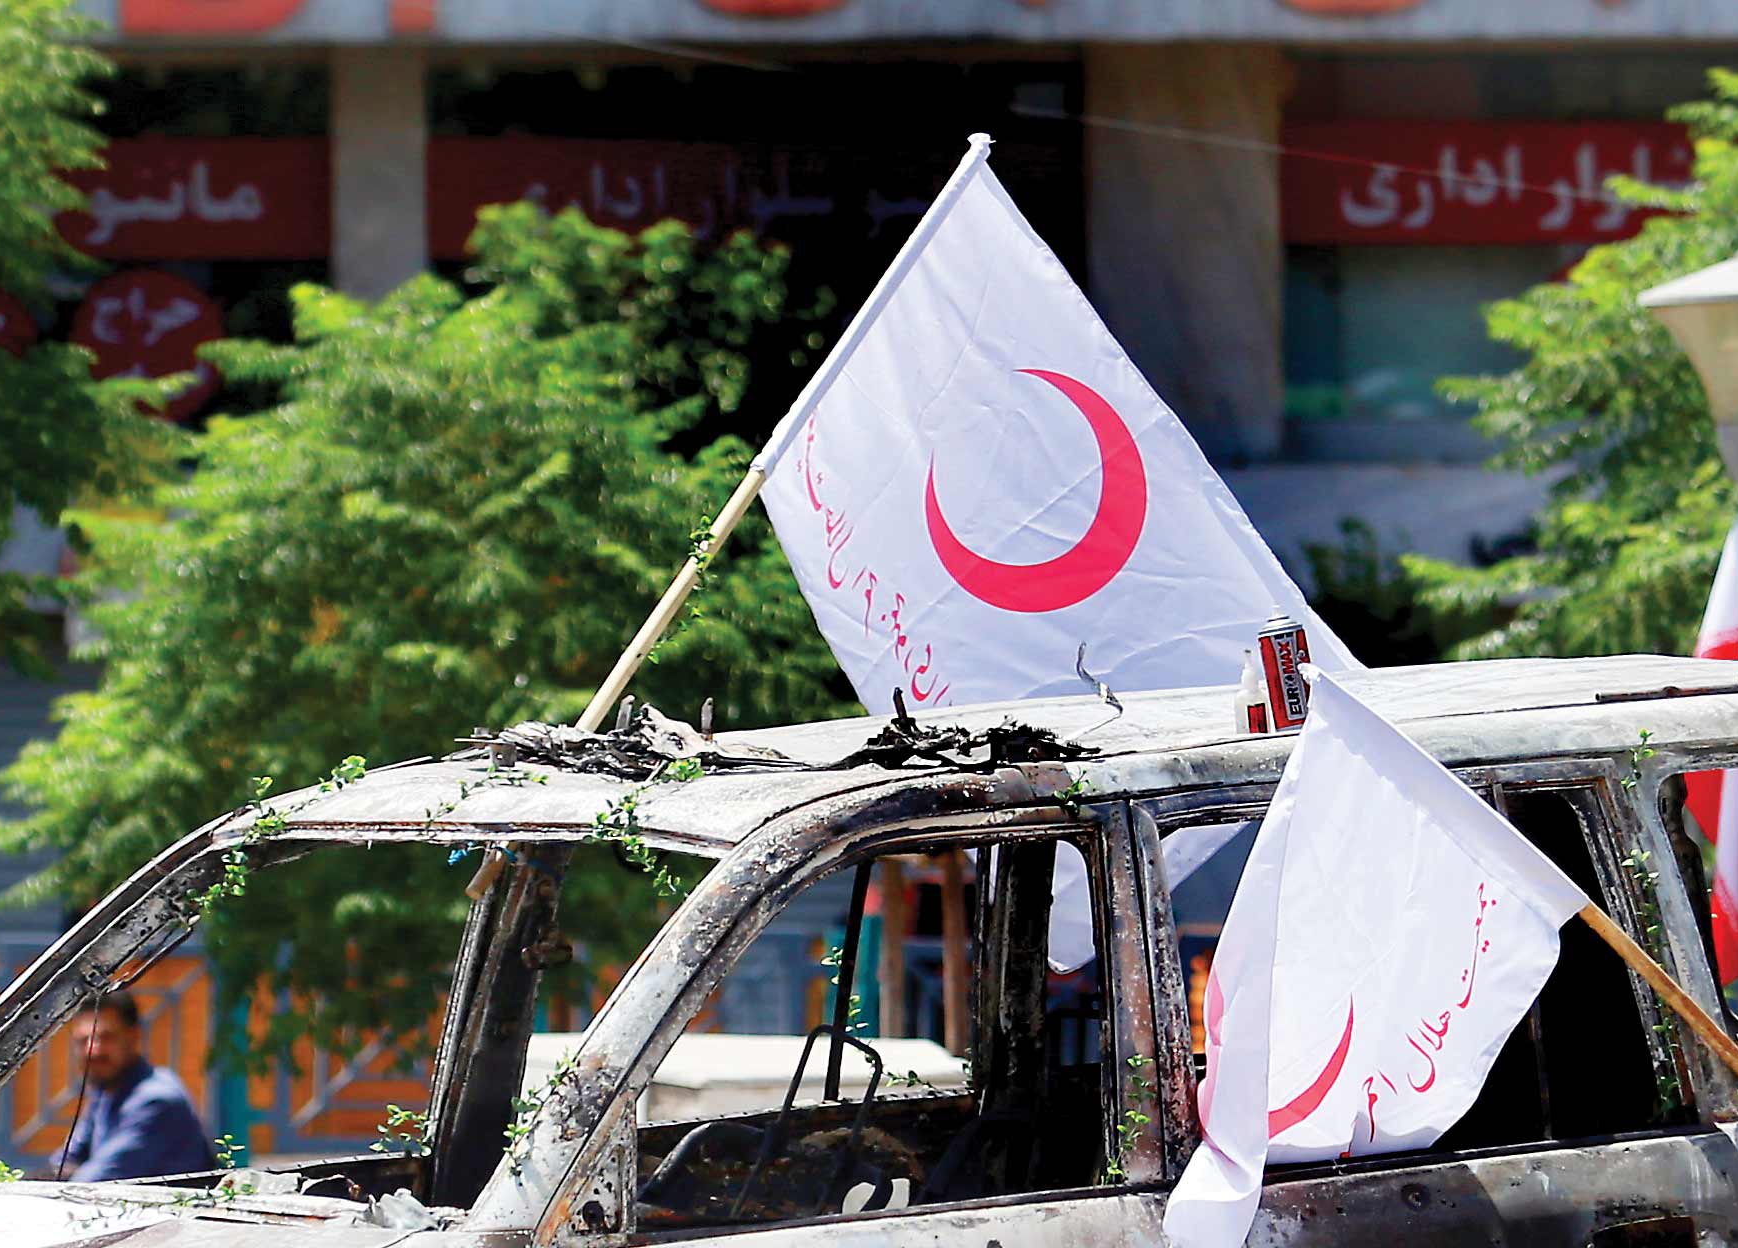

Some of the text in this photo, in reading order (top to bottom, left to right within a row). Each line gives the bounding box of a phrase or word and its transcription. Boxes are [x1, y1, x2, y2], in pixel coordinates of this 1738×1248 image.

[1340, 144, 1523, 229] اداری
[91, 287, 204, 346] حراج
[1361, 881, 1497, 1144] جمعیت هلال احمر
